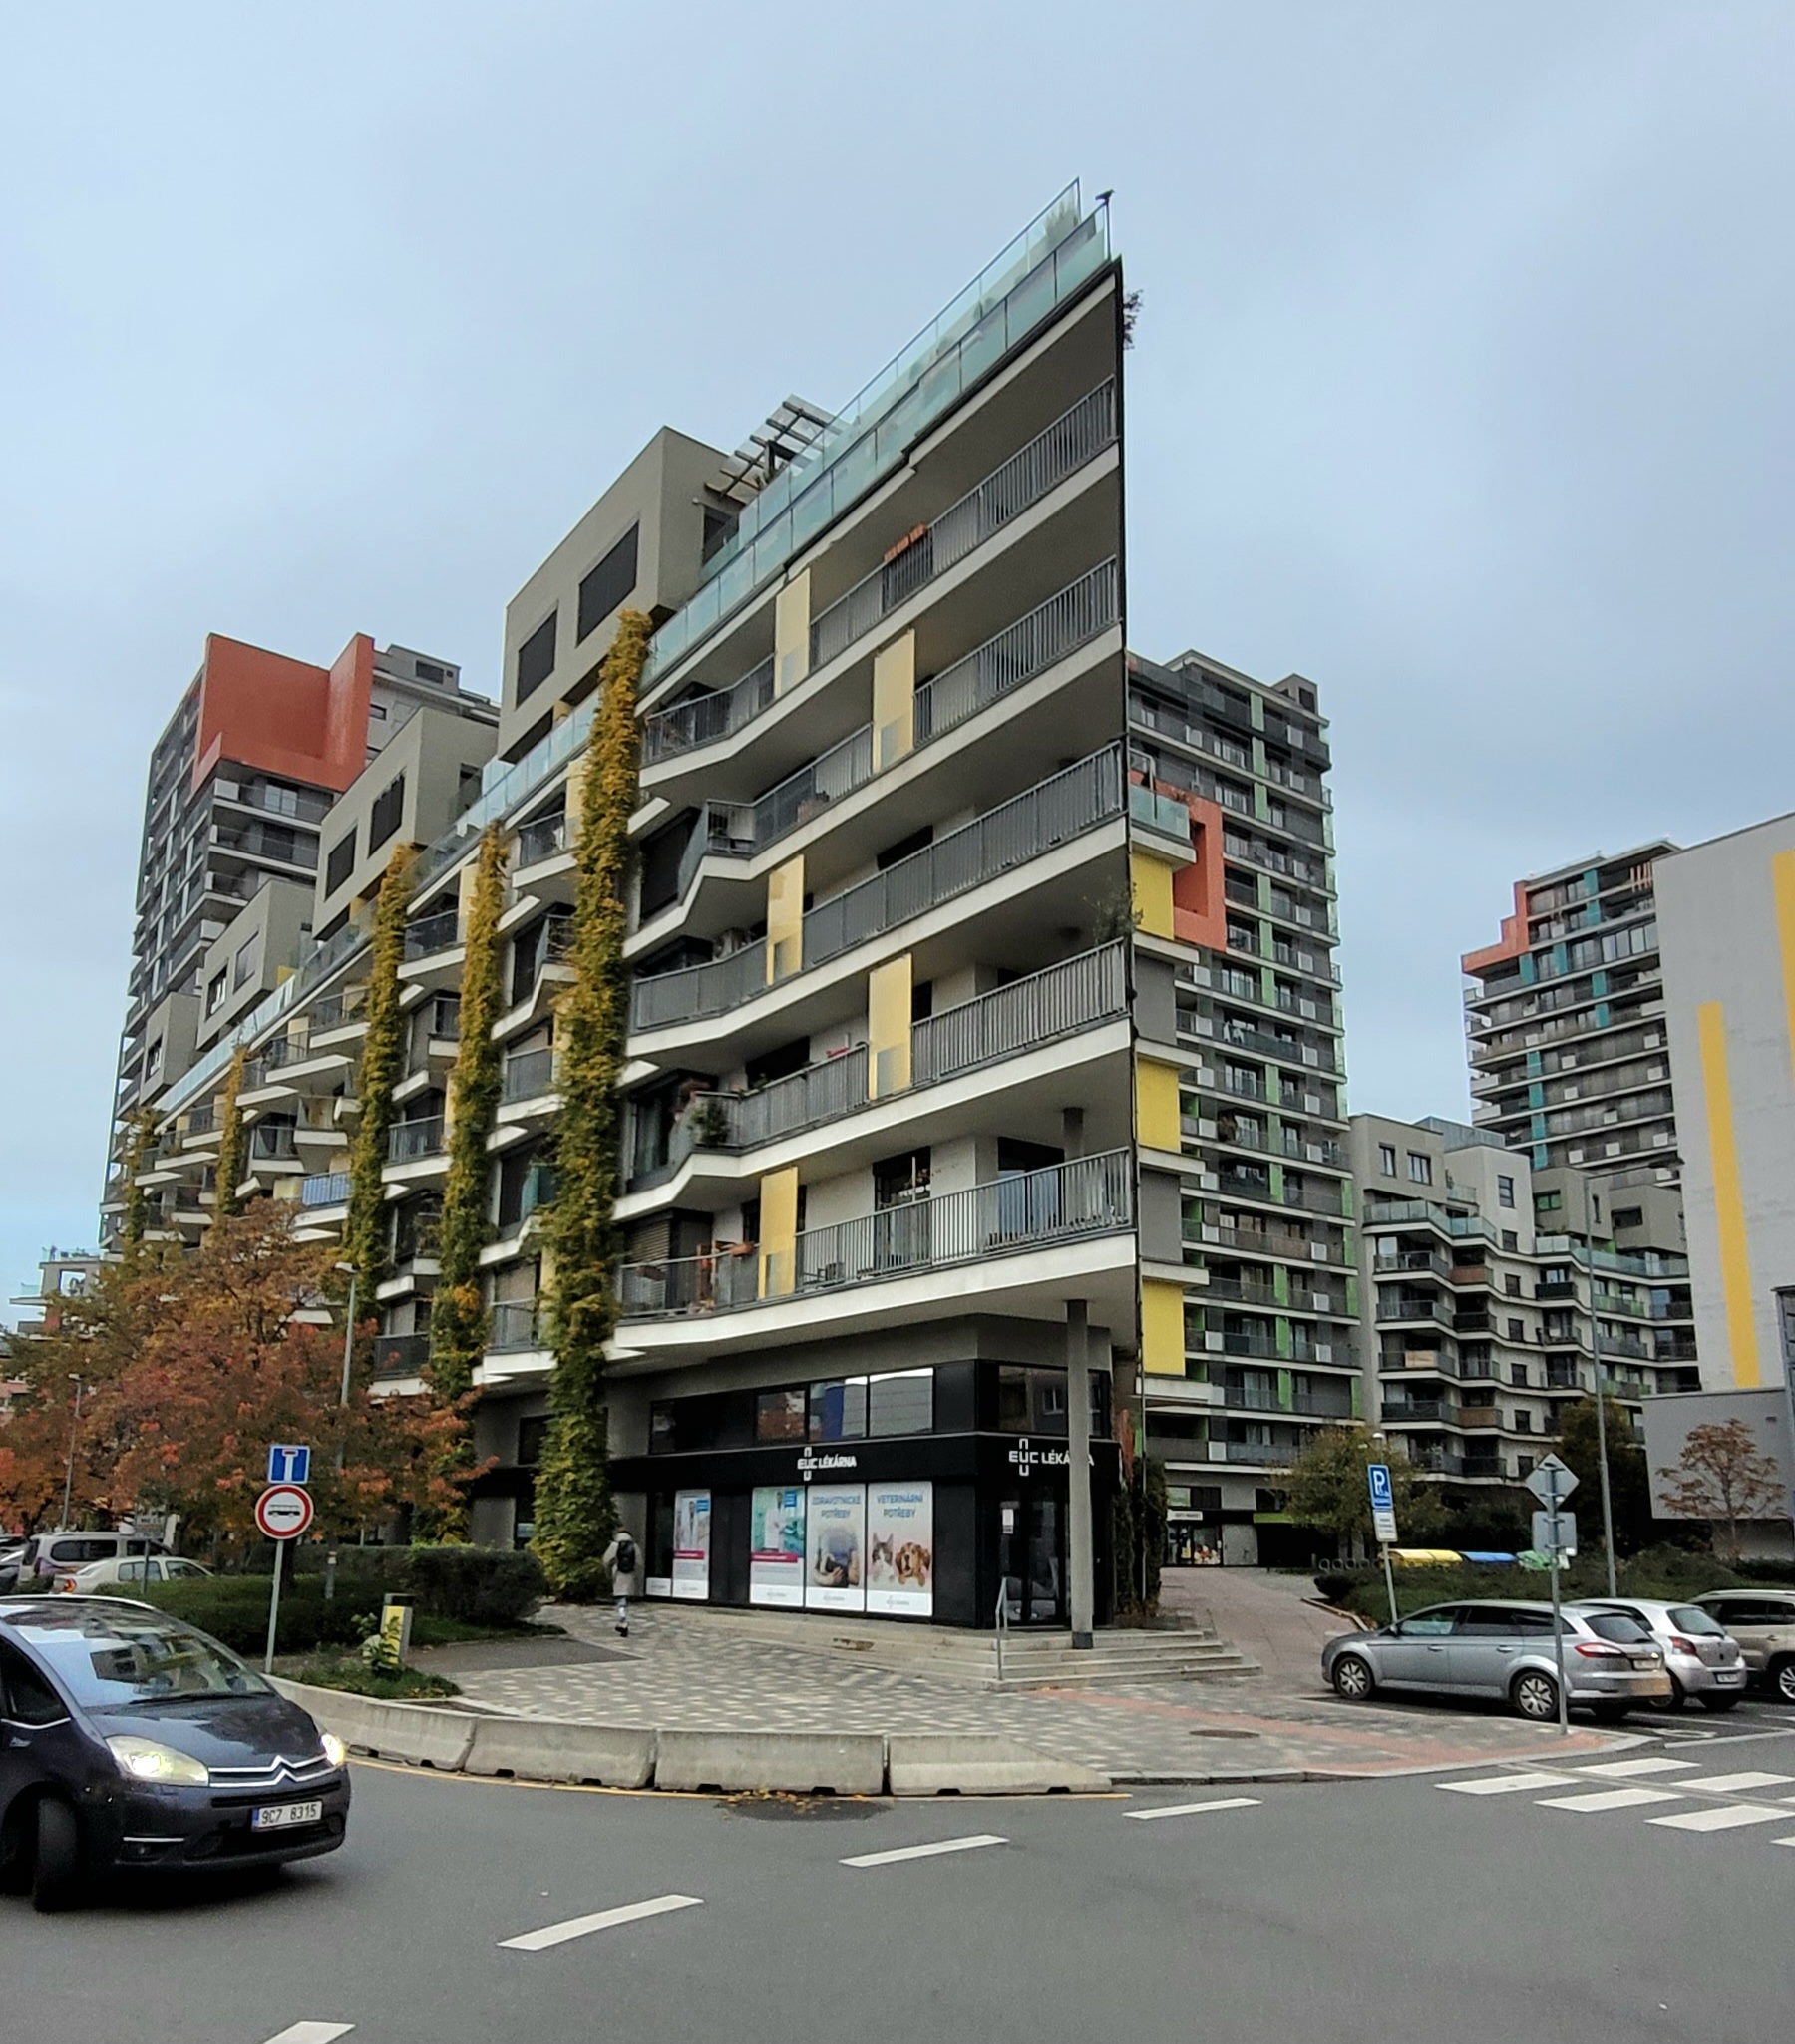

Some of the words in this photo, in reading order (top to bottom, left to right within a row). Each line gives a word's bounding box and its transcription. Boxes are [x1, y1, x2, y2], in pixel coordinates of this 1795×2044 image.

[818, 1454, 857, 1469] LÉKÁRNA
[261, 1809, 283, 1824] 9C7
[290, 1803, 317, 1821] 8315
